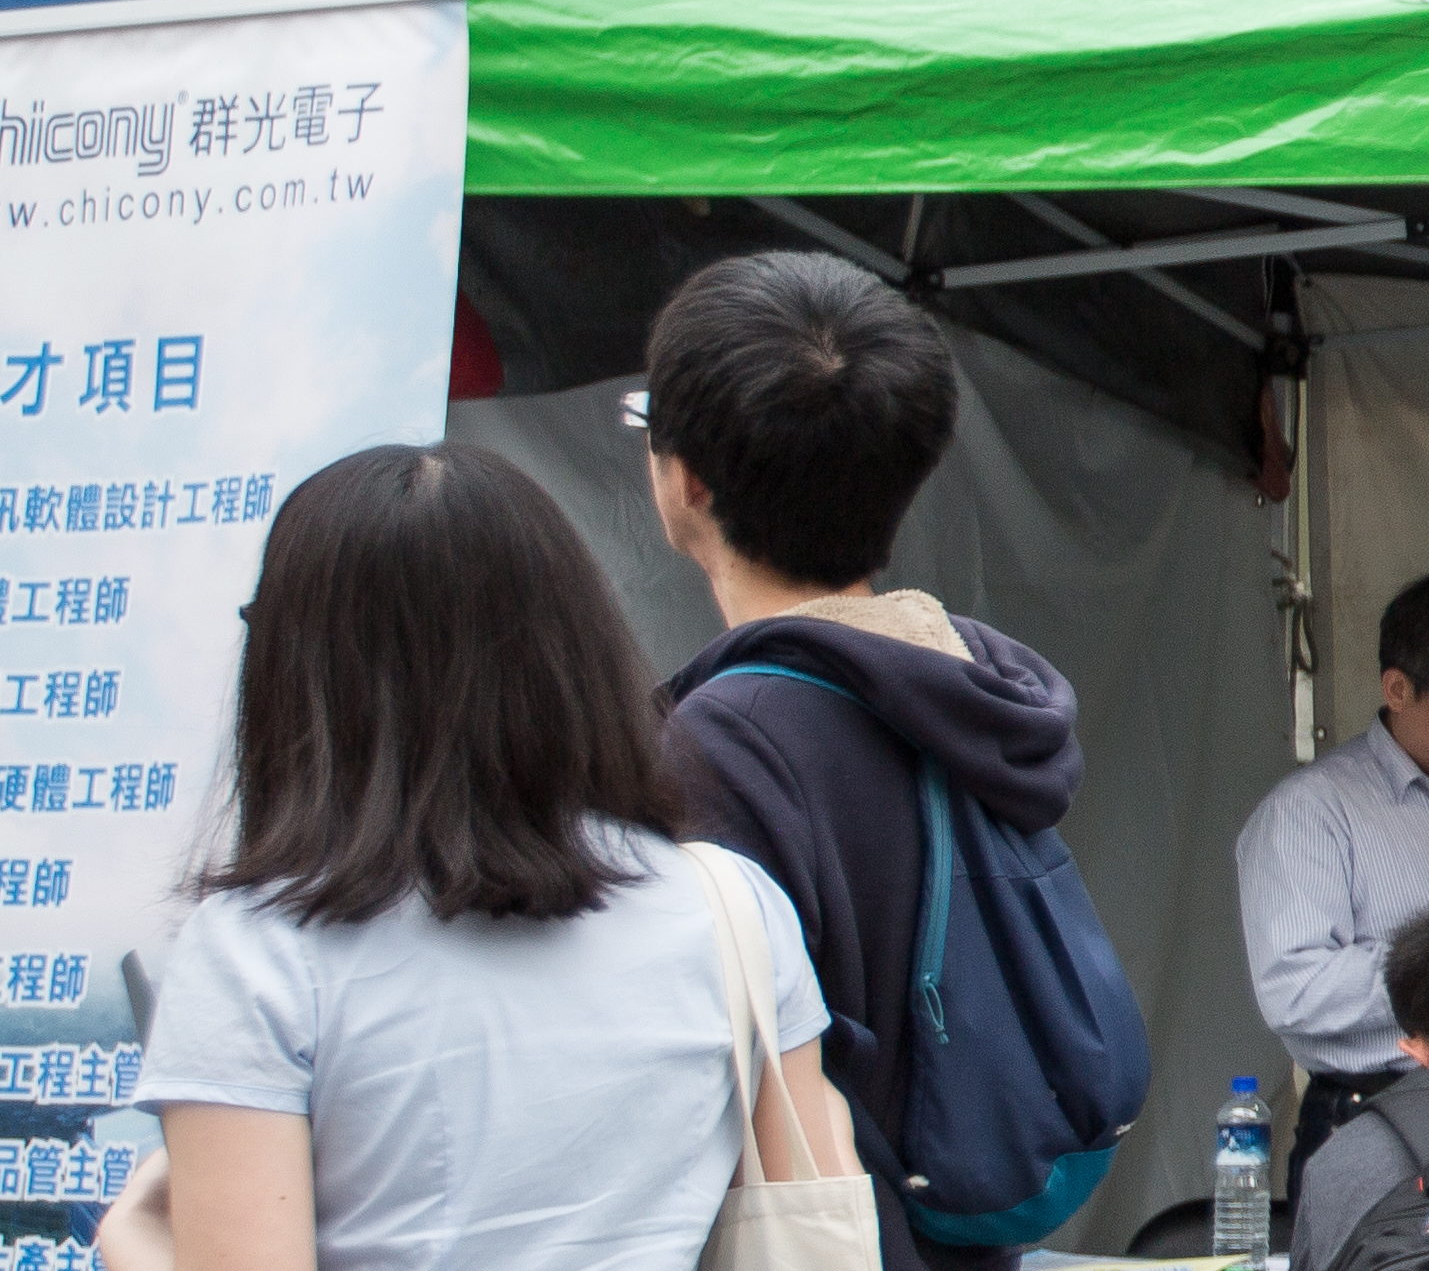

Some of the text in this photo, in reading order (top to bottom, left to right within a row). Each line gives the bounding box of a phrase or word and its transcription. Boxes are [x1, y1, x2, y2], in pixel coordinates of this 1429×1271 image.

[190, 82, 384, 157] 群光電子
[0, 334, 204, 417] 才項目
[0, 576, 130, 625] 工程師
[0, 669, 121, 719] 工程師
[0, 762, 178, 812] 硬體工程師
[0, 857, 73, 907] 程師
[0, 1048, 142, 1099] 工程主管
